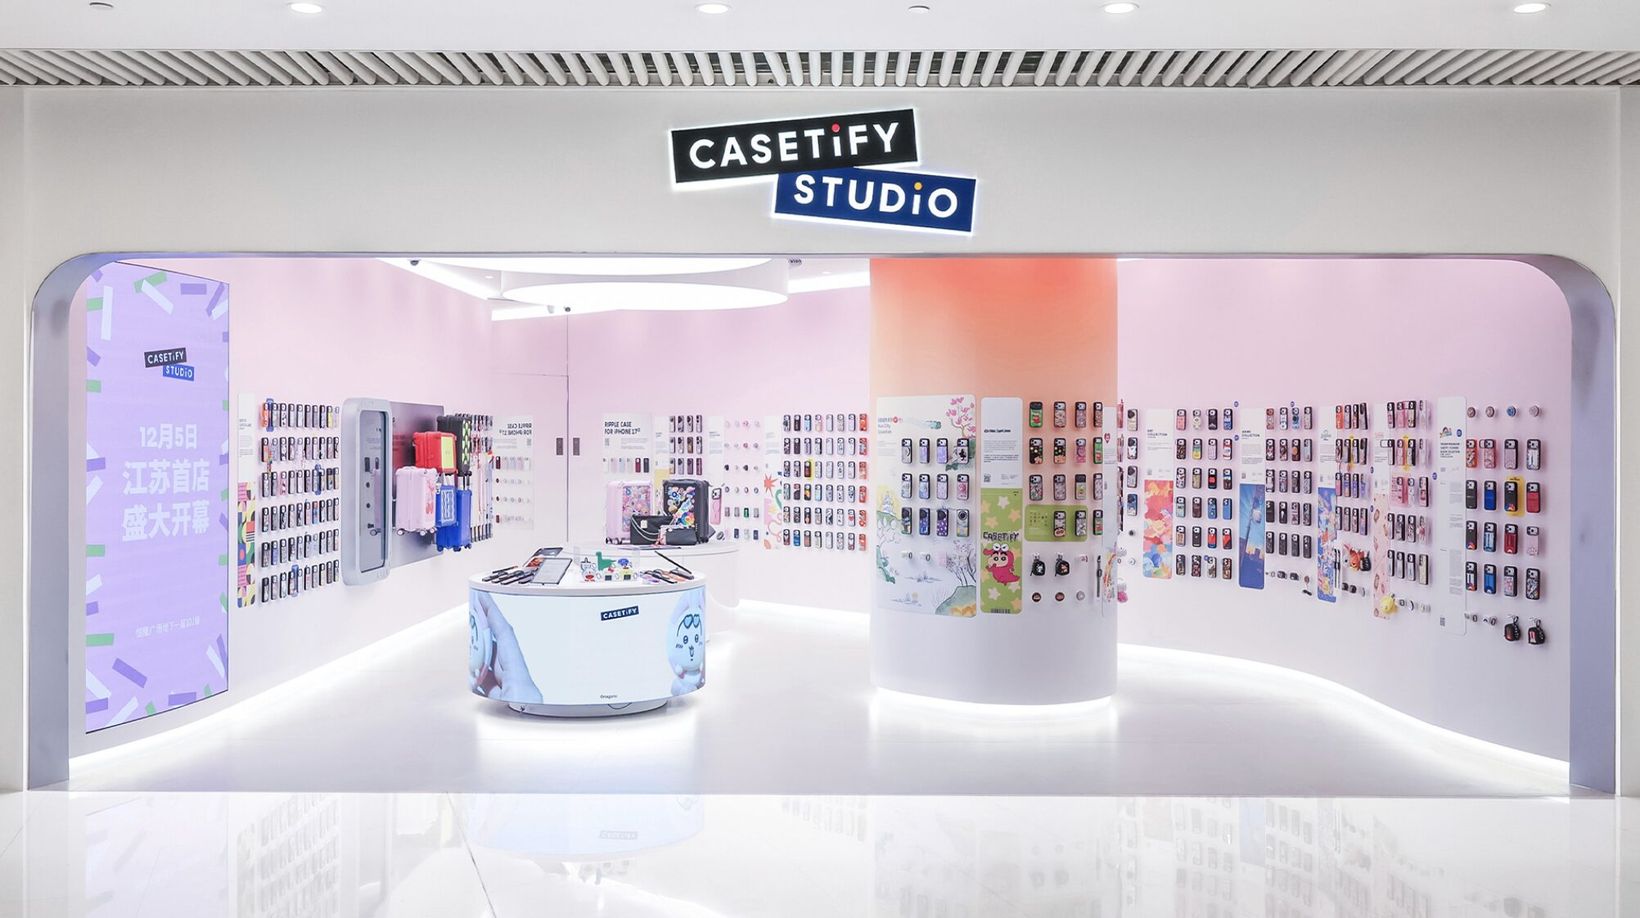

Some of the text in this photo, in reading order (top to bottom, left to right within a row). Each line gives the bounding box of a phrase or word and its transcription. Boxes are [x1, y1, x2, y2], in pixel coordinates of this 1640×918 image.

[689, 121, 899, 169] CASETiFY
[793, 173, 959, 219] STUDiO
[147, 351, 185, 365] CASETiFY
[165, 365, 193, 378] STUDiO
[139, 423, 197, 449] 12月5日
[122, 458, 210, 495] 江苏首店
[122, 499, 210, 542] 盛大开幕
[602, 607, 638, 619] CASETiFY
